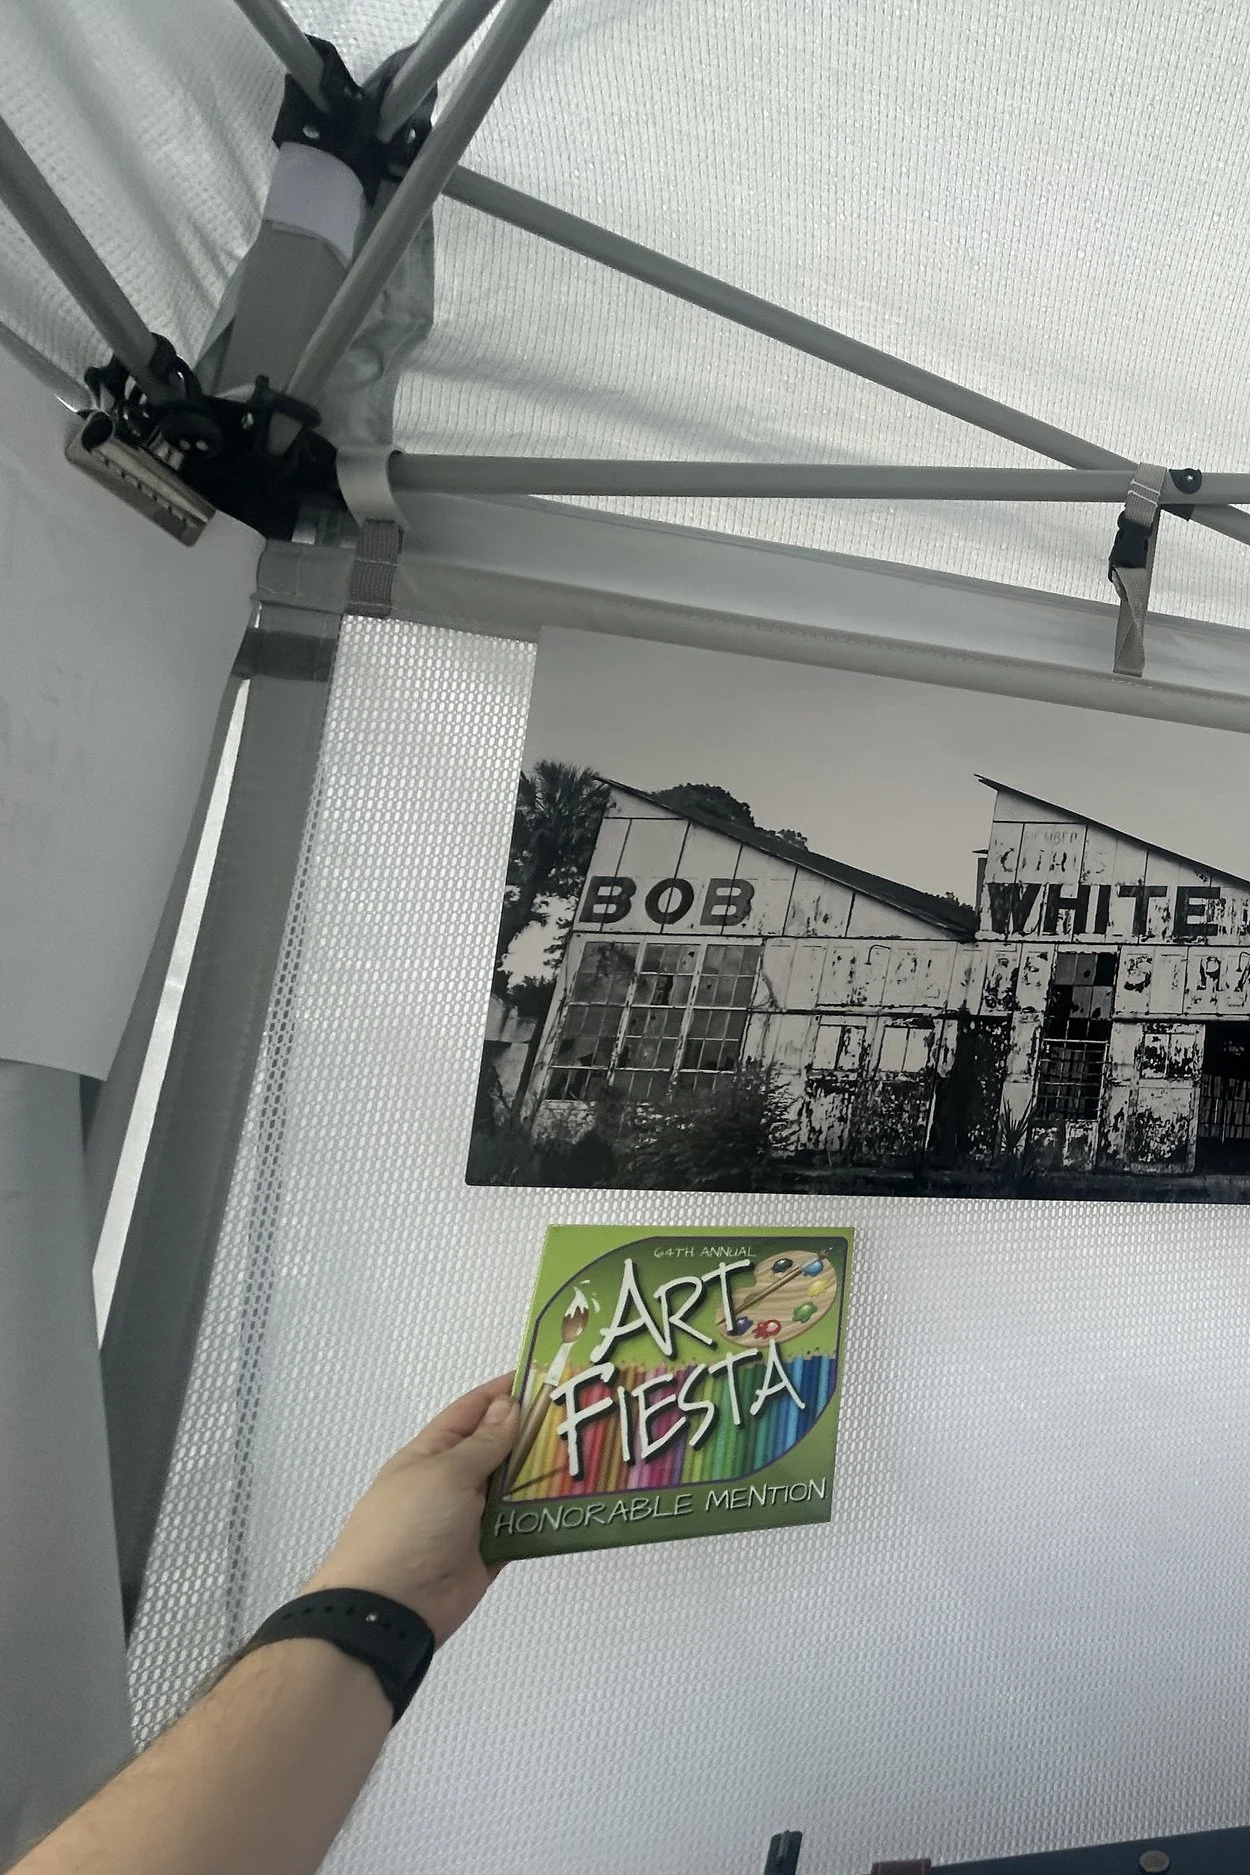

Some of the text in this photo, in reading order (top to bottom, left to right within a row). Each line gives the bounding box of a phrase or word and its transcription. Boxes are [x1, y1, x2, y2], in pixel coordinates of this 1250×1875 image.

[579, 875, 755, 926] BOB
[988, 883, 1221, 936] WHITE
[653, 1246, 757, 1258] 64TH ANNUAL
[590, 1258, 755, 1362] ART
[550, 1337, 807, 1478] FIESTA
[494, 1477, 827, 1537] HONORABLE MENTION
